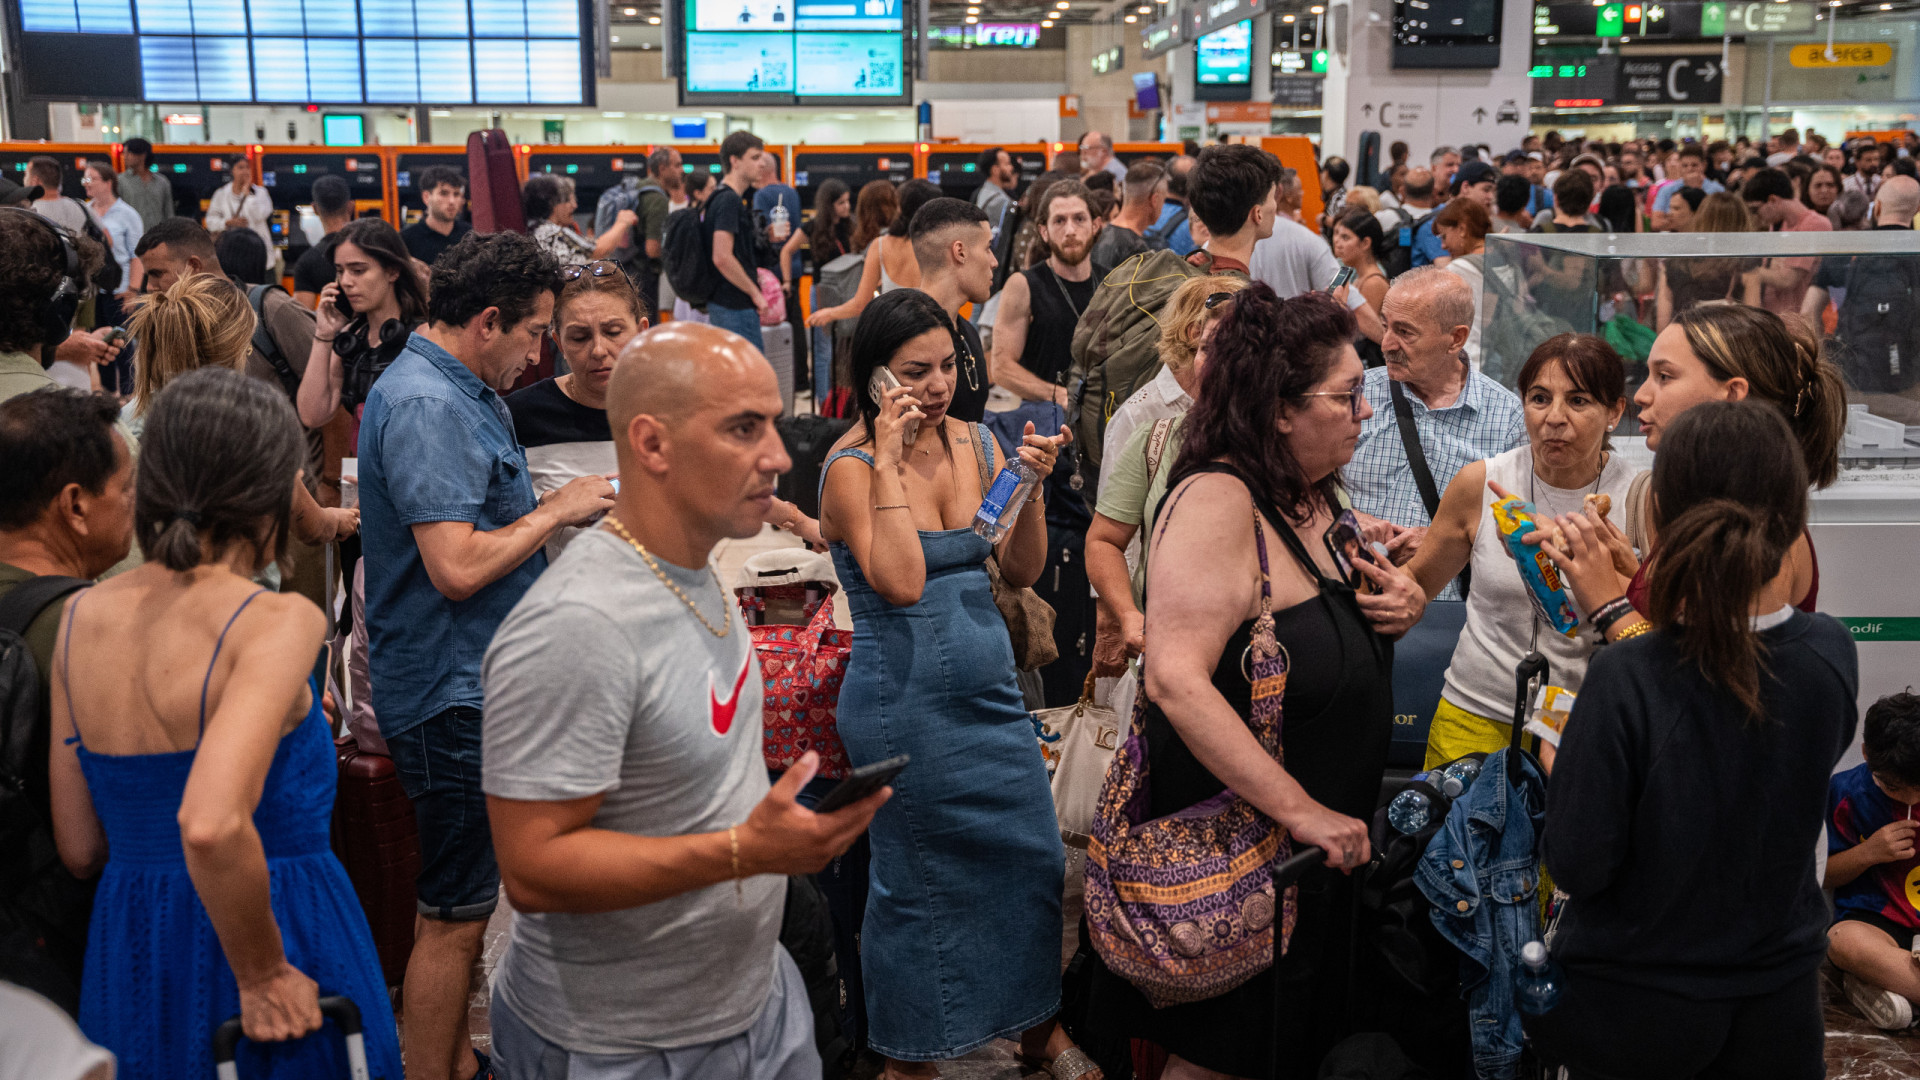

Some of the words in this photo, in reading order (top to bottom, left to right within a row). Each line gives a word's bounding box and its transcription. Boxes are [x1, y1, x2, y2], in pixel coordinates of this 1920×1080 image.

[1744, 3, 1761, 32] C
[1667, 58, 1690, 101] C
[1379, 101, 1393, 128] C
[1850, 622, 1884, 634] adif
[1393, 713, 1418, 725] or
